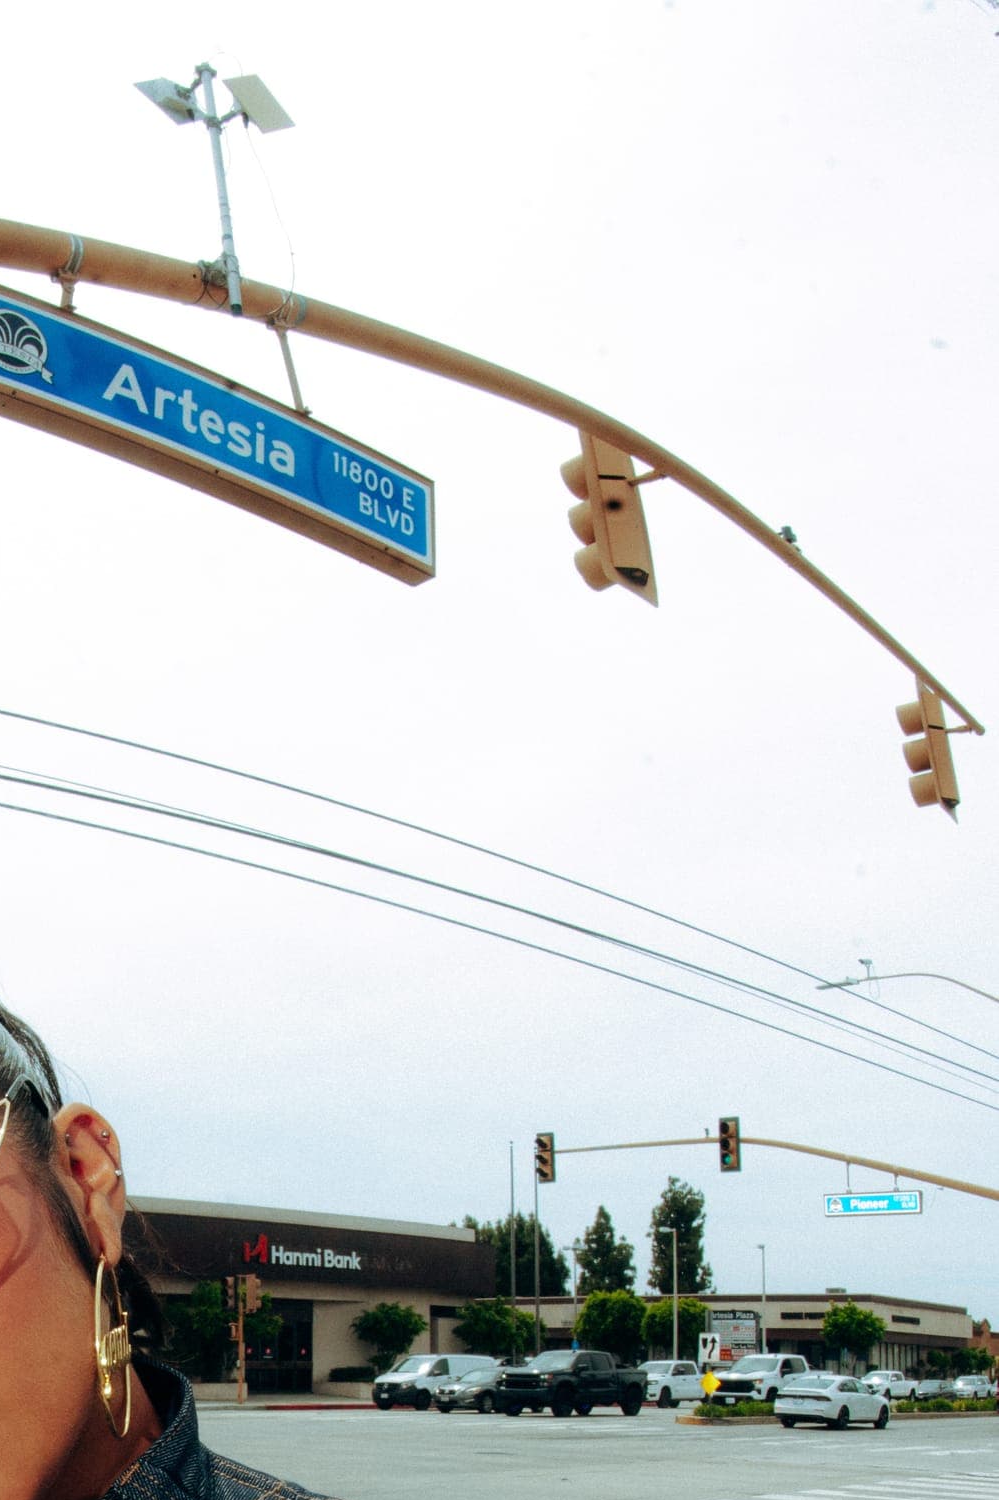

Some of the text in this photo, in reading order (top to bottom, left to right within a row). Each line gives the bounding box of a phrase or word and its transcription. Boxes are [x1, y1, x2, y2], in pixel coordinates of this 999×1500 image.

[102, 364, 295, 477] Artesia
[333, 452, 415, 511] 11800 E
[359, 491, 414, 536] BLVD
[850, 1199, 889, 1210] Pioneer
[271, 1245, 361, 1270] Hanmi Bank
